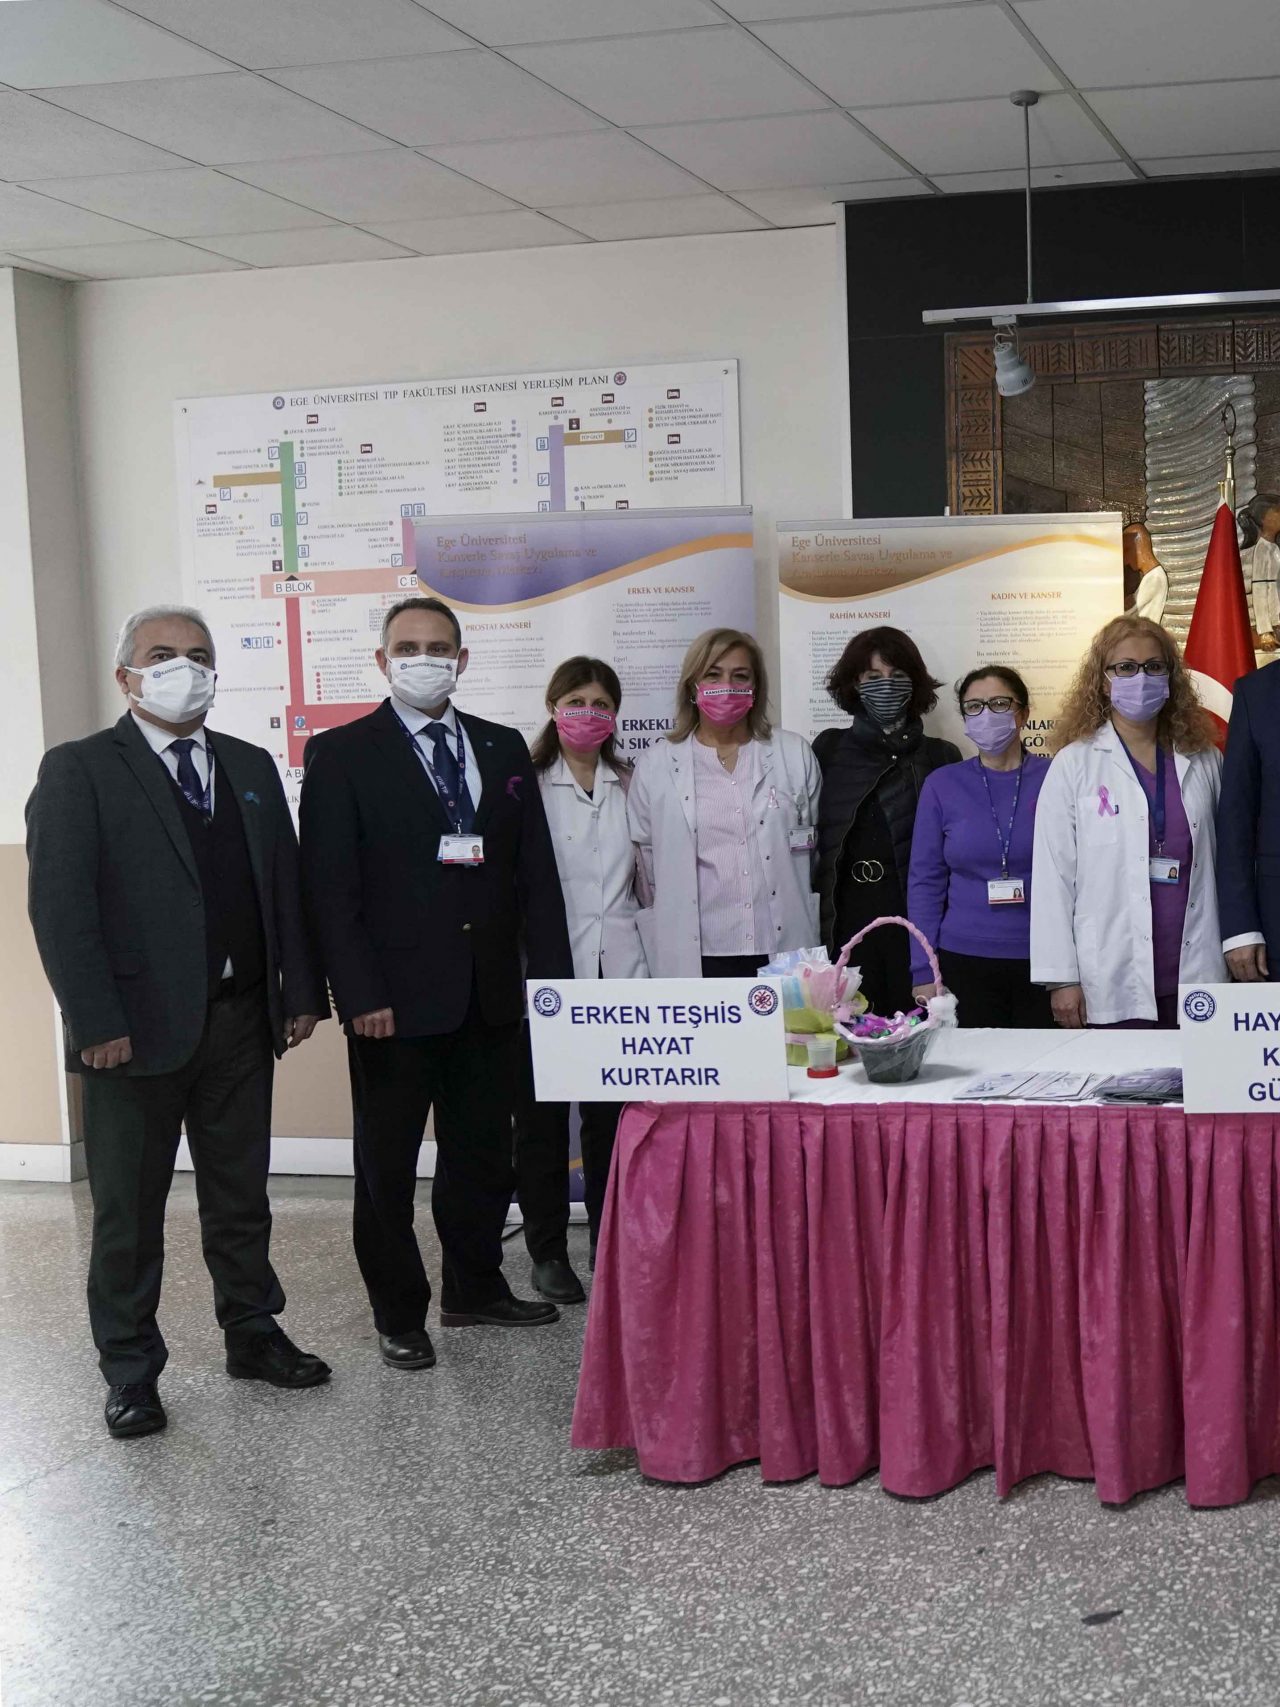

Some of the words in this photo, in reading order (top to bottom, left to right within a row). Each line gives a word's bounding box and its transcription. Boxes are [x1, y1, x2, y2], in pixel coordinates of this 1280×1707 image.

[290, 397, 309, 407] EGE
[313, 391, 378, 405] ÜNİVERSİTESİ
[383, 391, 399, 400] TIP
[403, 385, 457, 399] FAKÜLTESİ
[461, 382, 517, 394] HASTANESİ
[522, 376, 573, 390] YERLEŞİM
[578, 375, 609, 386] PLANI
[436, 536, 456, 549] Ege
[460, 533, 528, 547] Üniversitesi
[791, 536, 811, 550] Ege
[814, 533, 881, 547] Üniversitesi
[792, 551, 840, 563] Kanserle
[844, 550, 875, 562] Savaş
[879, 549, 936, 563] Uygulama
[940, 551, 953, 560] ve
[276, 584, 283, 593] B
[285, 582, 313, 592] BLOK
[399, 576, 408, 587] C
[627, 586, 651, 595] ERKEK
[653, 586, 663, 594] VE
[664, 585, 695, 594] KANSER
[991, 592, 1017, 601] KADIN
[1018, 592, 1028, 600] VE
[1030, 591, 1062, 600] KANSER
[829, 610, 856, 620] RAHİM
[858, 610, 891, 619] KANSERİ
[465, 623, 498, 632] PROSTAT
[500, 621, 532, 630] KANSERİ
[1022, 719, 1055, 730] NLAR
[628, 737, 651, 750] SIK
[1022, 733, 1047, 748] GÖ
[285, 769, 293, 778] A
[571, 1005, 651, 1025] ERKEN
[657, 1001, 742, 1029] TEŞHİS
[621, 1037, 694, 1056] HAYAT
[600, 1067, 721, 1087] KURTARIR
